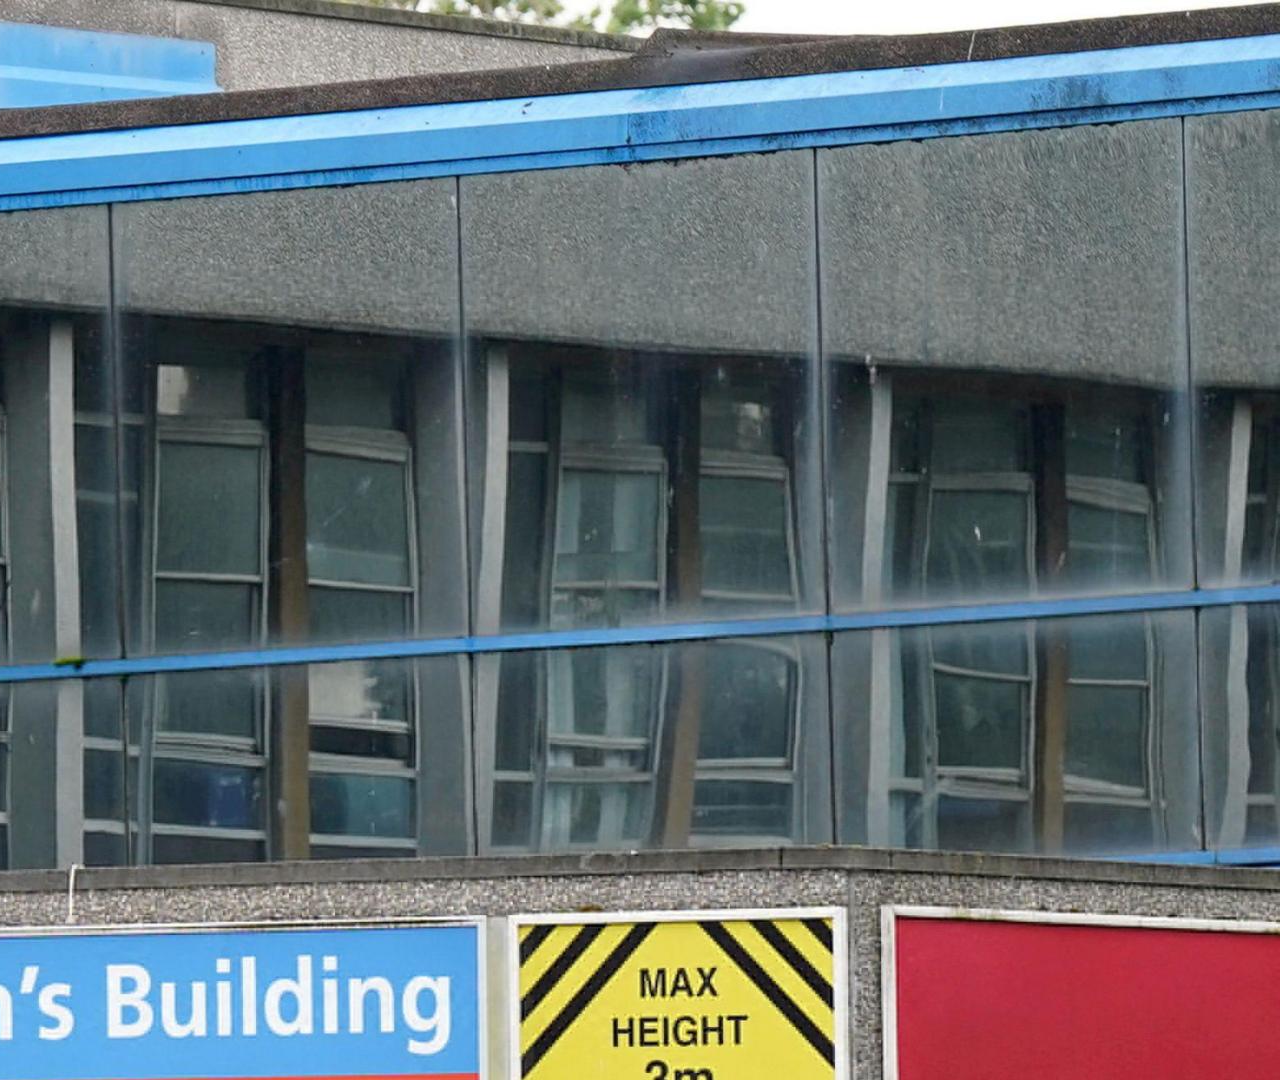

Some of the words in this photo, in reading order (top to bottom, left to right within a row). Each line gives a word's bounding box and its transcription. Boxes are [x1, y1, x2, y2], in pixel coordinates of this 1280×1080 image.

[639, 967, 718, 998] MAX
[105, 954, 452, 1055] Building
[612, 1015, 749, 1047] HEIGHT
